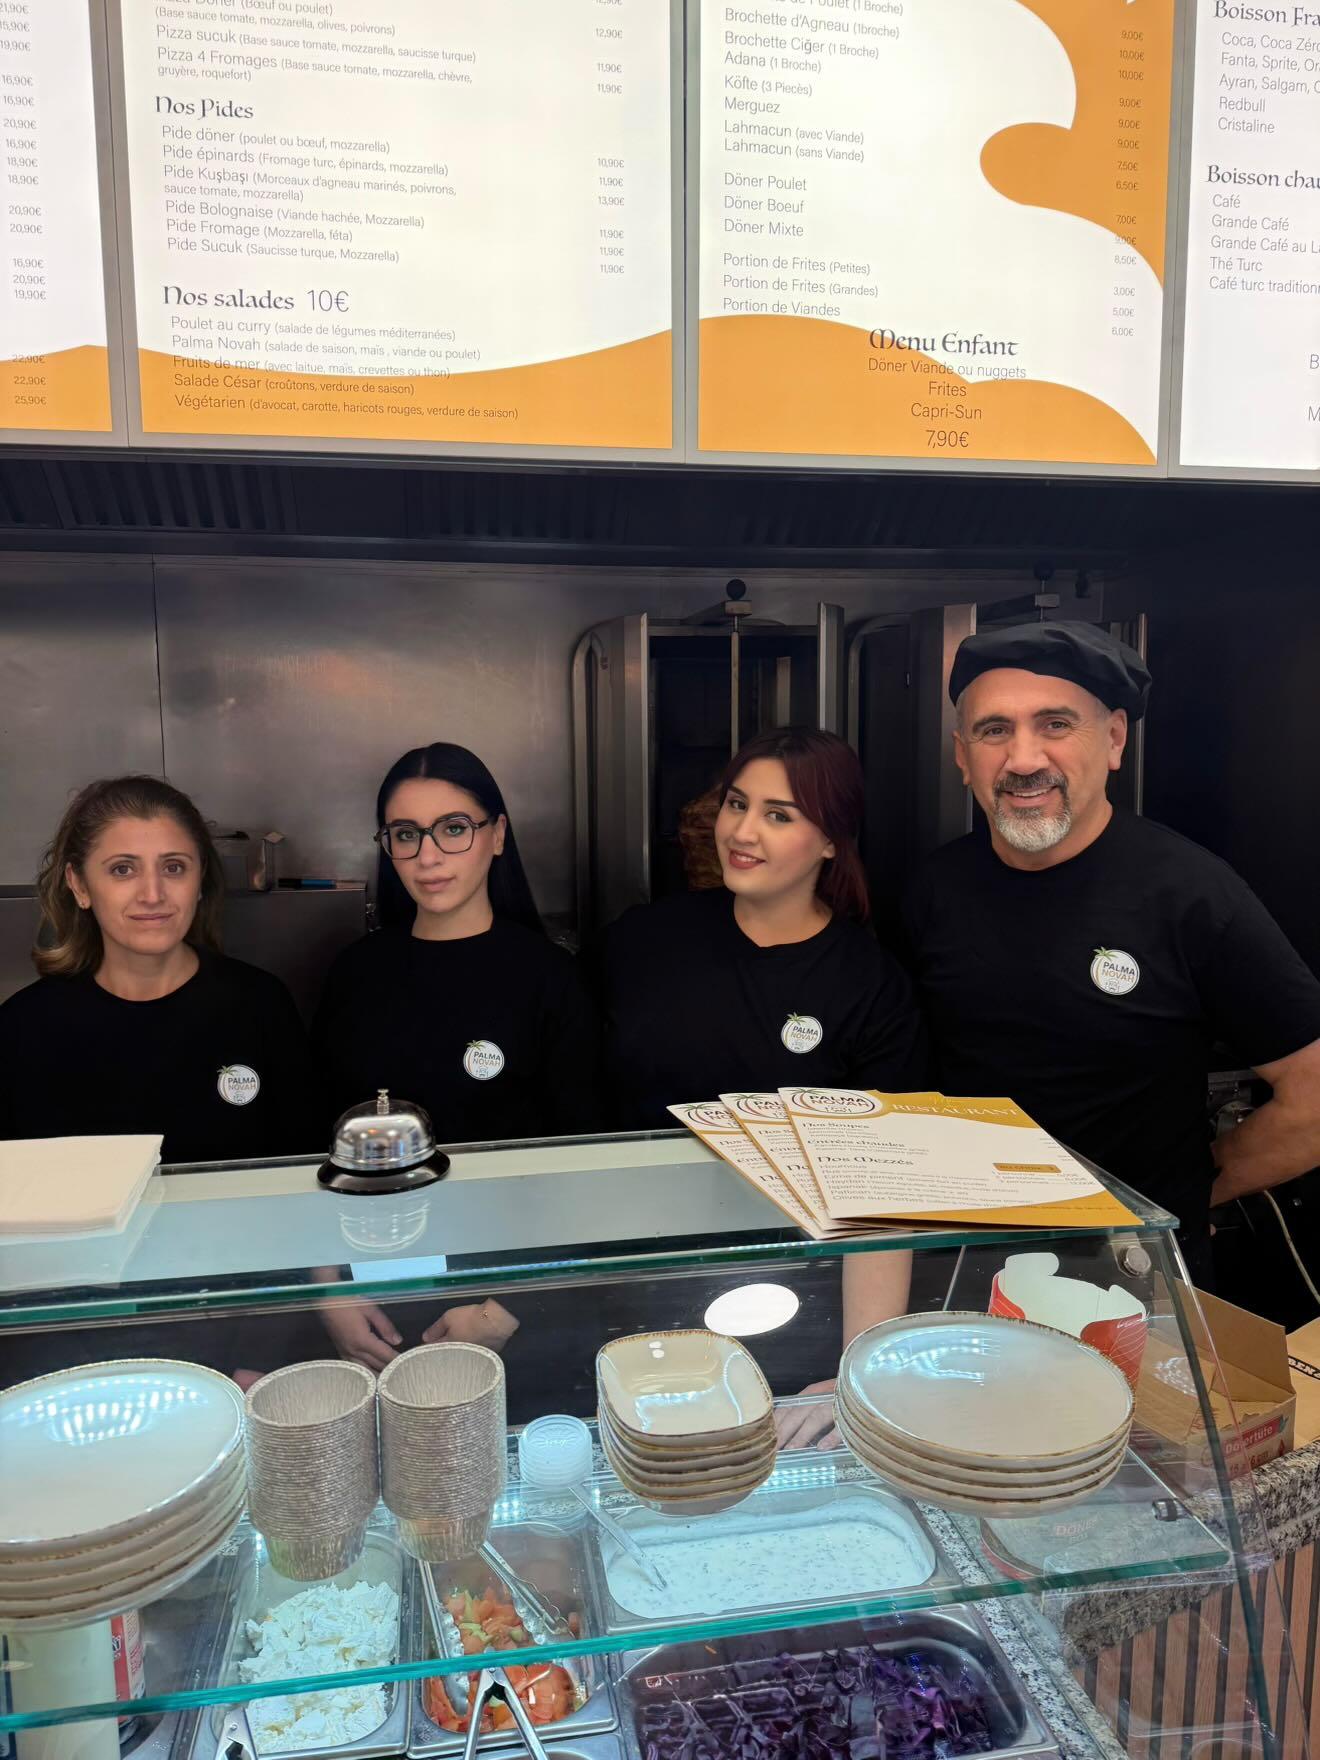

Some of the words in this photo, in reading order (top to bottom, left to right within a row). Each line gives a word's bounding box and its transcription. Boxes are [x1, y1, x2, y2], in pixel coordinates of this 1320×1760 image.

[726, 8, 787, 26] Brochette
[1213, 0, 1288, 23] Boisson
[157, 24, 193, 40] Pizza
[197, 30, 236, 43] sucuk
[1220, 32, 1256, 48] Coca,
[1260, 35, 1292, 50] Coca
[158, 46, 192, 62] Pizza
[198, 50, 207, 63] 4
[211, 50, 277, 70] Fromages
[724, 50, 766, 67] Adana
[782, 58, 821, 74] Broche)
[1222, 52, 1258, 69] Fanta,
[1262, 55, 1301, 72] Sprite,
[725, 75, 758, 91] Köfte
[762, 80, 772, 93] (3
[1217, 73, 1257, 90] Ayran,
[1262, 76, 1310, 94] Salgam,
[154, 96, 195, 116] Nos
[198, 98, 254, 120] Pides
[725, 96, 780, 115] Merguez
[1220, 96, 1265, 112] Redbull
[4, 118, 36, 129] 20,90€
[725, 120, 791, 136] Lahmacun
[796, 128, 822, 140] (avec
[826, 130, 864, 145] Viande)
[1218, 117, 1275, 134] Cristaline
[163, 125, 193, 140] Pide
[194, 128, 235, 142] döner
[240, 132, 276, 146] (poulet
[280, 138, 293, 146] ou
[296, 136, 327, 150] bœuf,
[331, 141, 390, 154] mozzarella)
[8, 156, 38, 167] 18,90€
[164, 144, 192, 160] Pide
[197, 146, 255, 163] épinards
[259, 152, 310, 168] (Fromage
[314, 156, 336, 168] turc,
[339, 158, 386, 172] épinards,
[390, 164, 448, 176] mozzarella)
[164, 164, 194, 178] Pide
[253, 172, 310, 186] (Morceaux
[364, 181, 407, 192] marinés,
[411, 183, 456, 196] poivrons,
[724, 172, 763, 188] Döner
[768, 176, 807, 191] Poulet
[1205, 164, 1282, 187] Boisson
[724, 194, 763, 210] Döner
[768, 198, 804, 213] Boeuf
[1211, 194, 1240, 208] Café
[166, 200, 195, 214] Pide
[200, 202, 273, 219] Bolognaise
[277, 208, 318, 221] (Viande
[322, 210, 362, 224] hachée,
[366, 213, 424, 229] Mozzarella)
[1212, 214, 1257, 229] Grande
[1262, 217, 1289, 231] Café
[167, 218, 197, 232] Pide
[199, 220, 260, 238] Fromage
[264, 226, 326, 240] (Mozzarella,
[330, 229, 352, 243] féta)
[168, 237, 197, 252] Pide
[200, 239, 243, 254] Sucuk
[246, 243, 297, 256] (Saucisse
[301, 248, 337, 260] turque,
[340, 249, 399, 263] Mozzarella)
[1211, 234, 1256, 250] Grande
[1260, 238, 1290, 252] Café
[1292, 242, 1306, 253] au
[724, 252, 770, 268] Portion
[772, 256, 788, 269] de
[792, 257, 825, 271] Frites
[830, 261, 870, 276] (Petites)
[1210, 256, 1233, 271] Thé
[1236, 258, 1263, 272] Turc
[1210, 276, 1239, 290] Café
[1240, 278, 1265, 291] turc
[15, 289, 46, 300] 19,90€
[162, 286, 208, 306] Nos
[214, 288, 295, 310] salades
[307, 290, 349, 312] 10€
[724, 298, 769, 312] Portion
[770, 300, 790, 313] de
[792, 301, 840, 317] Viandes
[172, 316, 213, 330] Poulet
[216, 321, 233, 331] au
[238, 322, 271, 335] curry
[275, 322, 312, 335] (salade
[316, 324, 328, 334] de
[332, 324, 376, 338] légumes
[380, 328, 455, 342] méditerranées)
[173, 334, 213, 348] Palma
[218, 337, 260, 350] Novah
[265, 340, 302, 352] (salade
[306, 342, 321, 352] de
[322, 345, 357, 355] saison,
[870, 328, 936, 352] Menu
[940, 330, 1020, 357] Enfant
[172, 355, 210, 368] Fruits
[214, 356, 230, 369] de
[235, 360, 260, 370] mer
[869, 358, 908, 372] Döner
[910, 360, 954, 374] Viande
[958, 366, 973, 375] ou
[978, 366, 1026, 382] nuggets
[14, 376, 46, 385] 22,90€
[175, 374, 219, 388] Salade
[223, 375, 262, 389] César
[265, 378, 318, 392] (croûtons,
[321, 379, 360, 392] verdure
[362, 381, 376, 393] de
[378, 382, 415, 396] saison)
[929, 380, 968, 397] Frites
[175, 394, 248, 410] Végétarien
[302, 402, 340, 413] carotte,
[344, 402, 384, 414] haricots
[388, 406, 424, 416] rouges,
[911, 402, 982, 421] Capri-Sun
[926, 430, 969, 448] 7,90€
[1102, 969, 1135, 983] NOVAH
[1103, 961, 1135, 975] PALMA
[793, 1025, 819, 1036] PALMA
[474, 1051, 501, 1060] PALMA
[809, 1095, 867, 1103] PALMA
[811, 1099, 870, 1107] NOVAH
